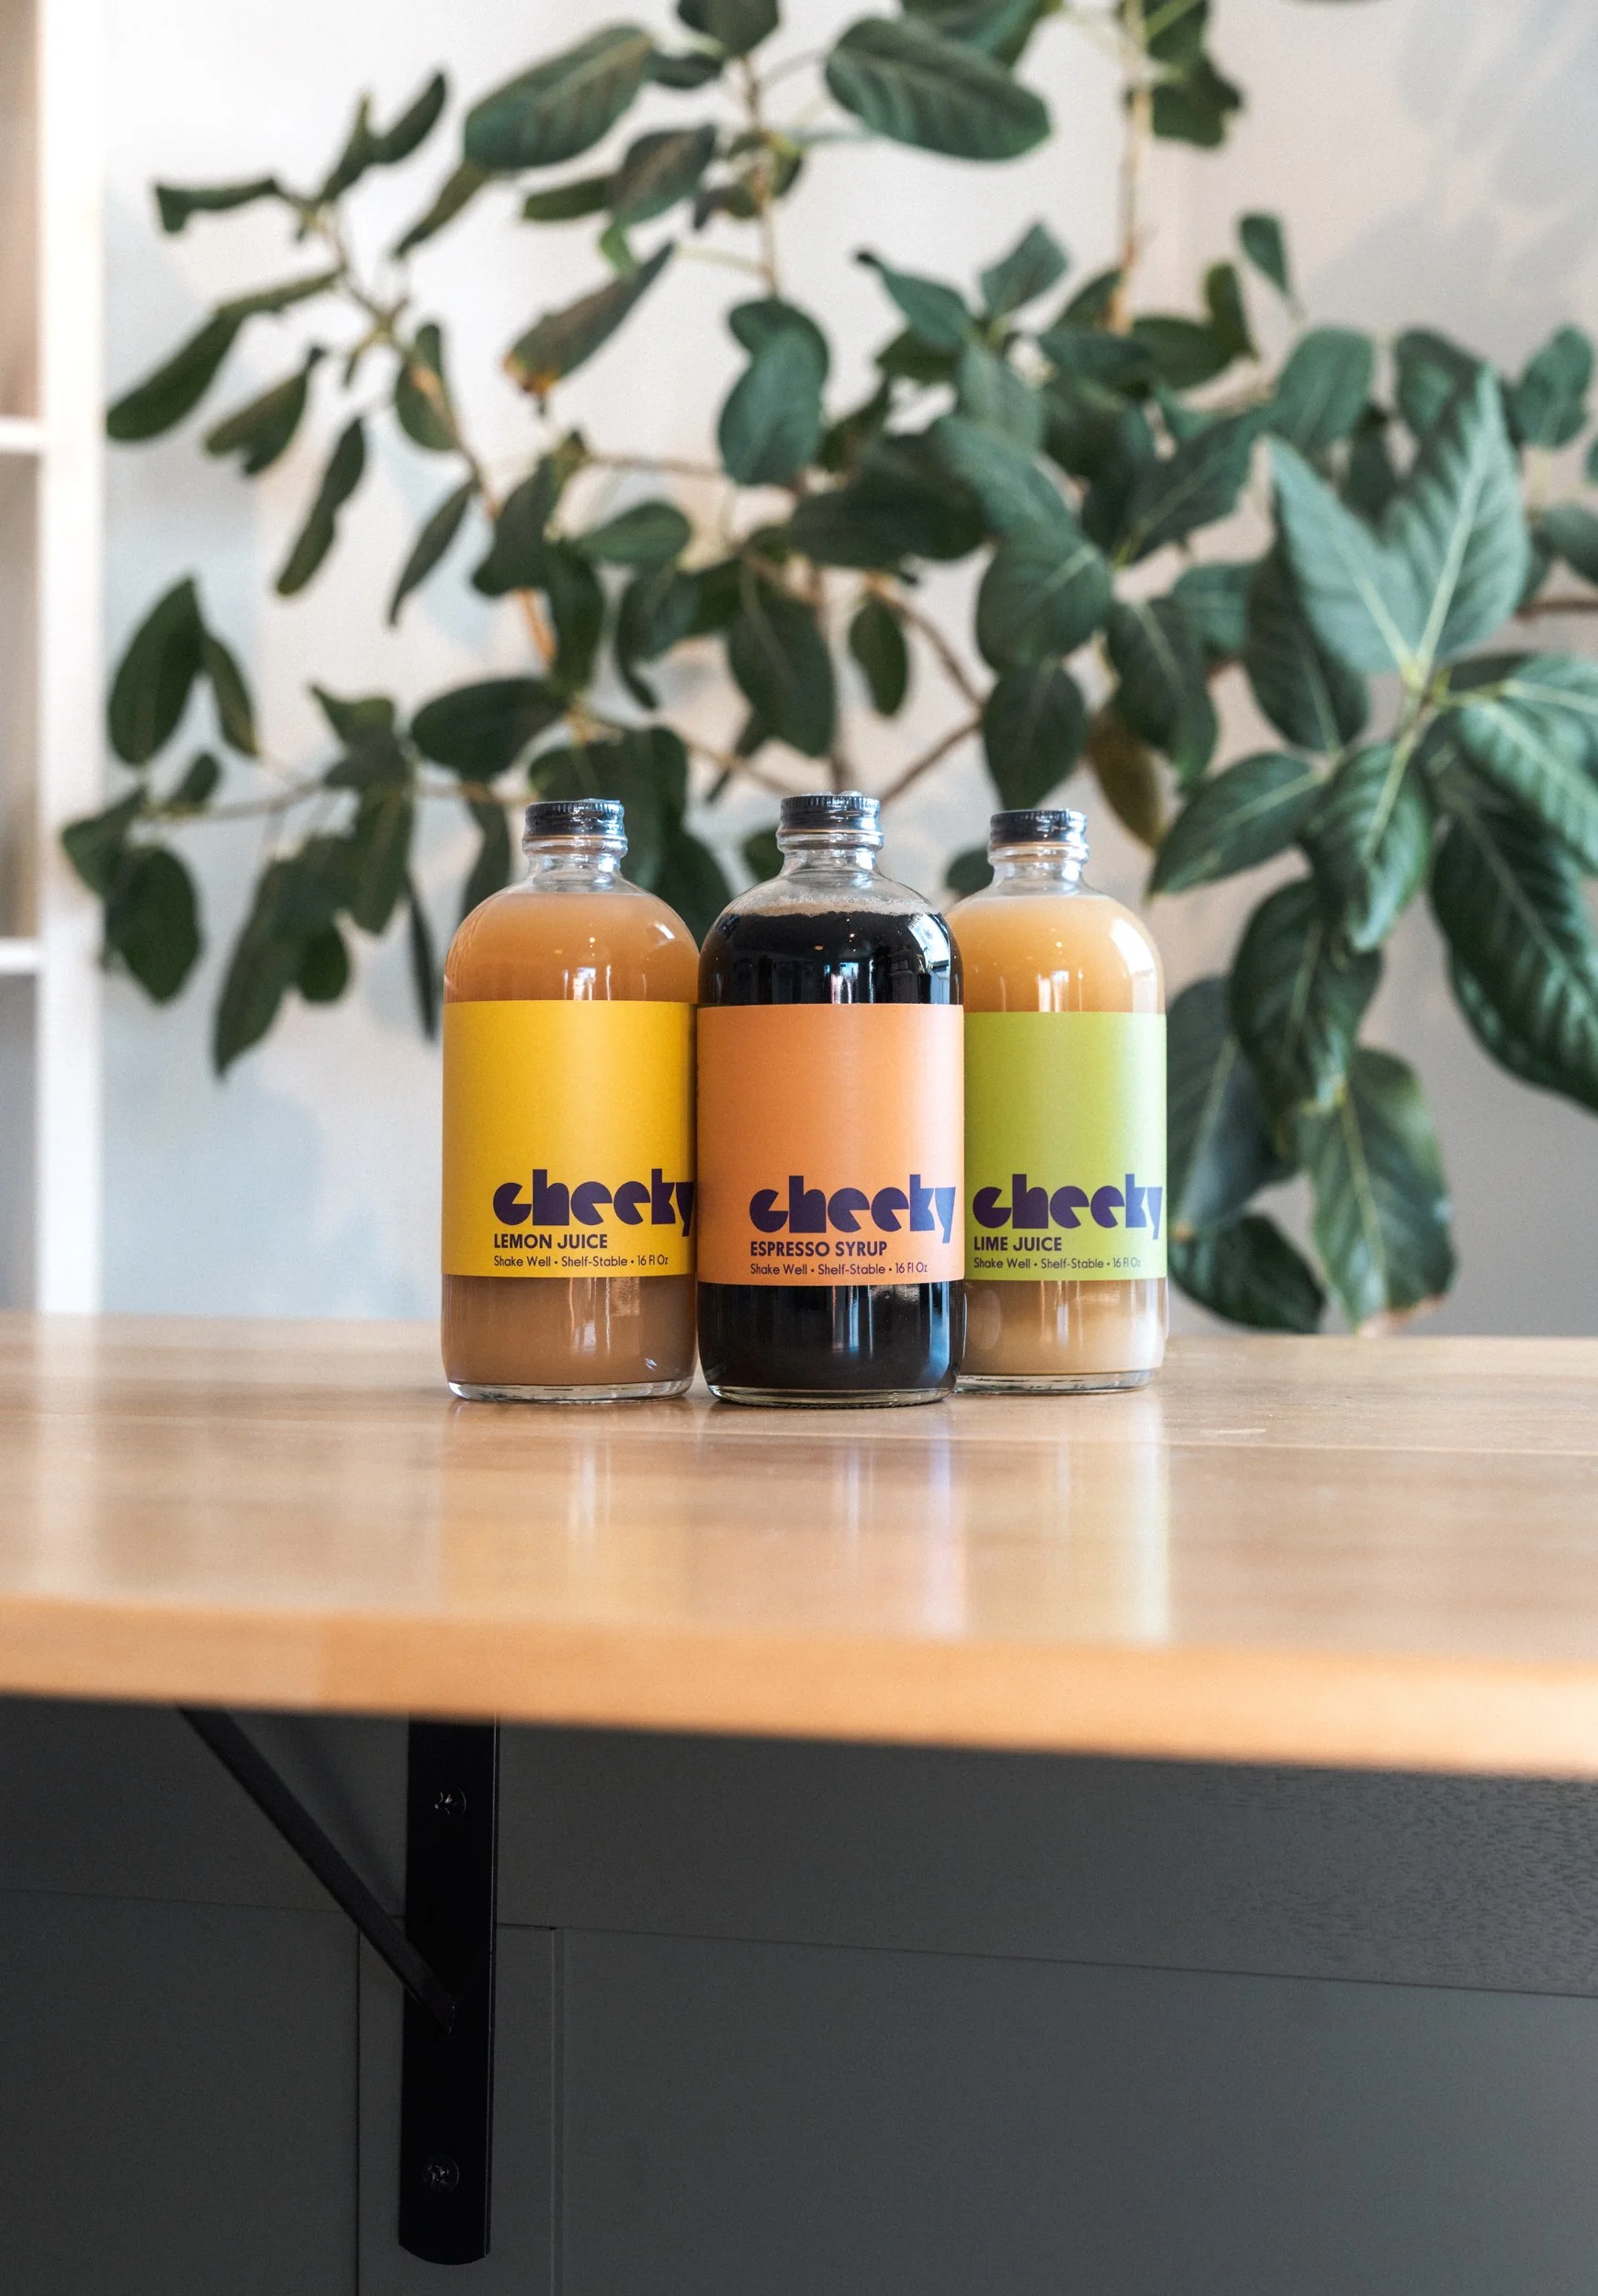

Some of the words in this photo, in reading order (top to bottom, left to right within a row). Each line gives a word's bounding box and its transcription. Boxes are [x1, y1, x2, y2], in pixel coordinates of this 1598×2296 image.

[493, 1169, 694, 1237] cheeky
[749, 1175, 955, 1244] cheeky
[973, 1174, 1163, 1240] cheeky
[494, 1234, 552, 1249] LEMON
[557, 1234, 607, 1248] JUICE
[973, 1237, 1007, 1251] LIME
[1013, 1237, 1062, 1251] JUICE
[750, 1242, 830, 1256] ESPRESSO
[836, 1242, 887, 1256] SYRUP
[494, 1255, 523, 1266] Shake
[526, 1255, 550, 1266] Well
[562, 1255, 627, 1266] Shelf-Stable
[637, 1255, 647, 1265] 16
[648, 1255, 656, 1265] Fl
[658, 1255, 668, 1265] Oz
[973, 1257, 1003, 1268] Shake
[1007, 1257, 1030, 1268] Well
[1041, 1257, 1104, 1268] Shelf-Stable
[1113, 1257, 1120, 1266] 16
[1131, 1257, 1141, 1266] Oz
[750, 1264, 780, 1275] Shake
[783, 1264, 807, 1275] Well
[818, 1264, 885, 1275] Shelf-Stable
[895, 1263, 905, 1273] 16
[907, 1263, 914, 1273] Fl
[916, 1263, 928, 1272] Oz
